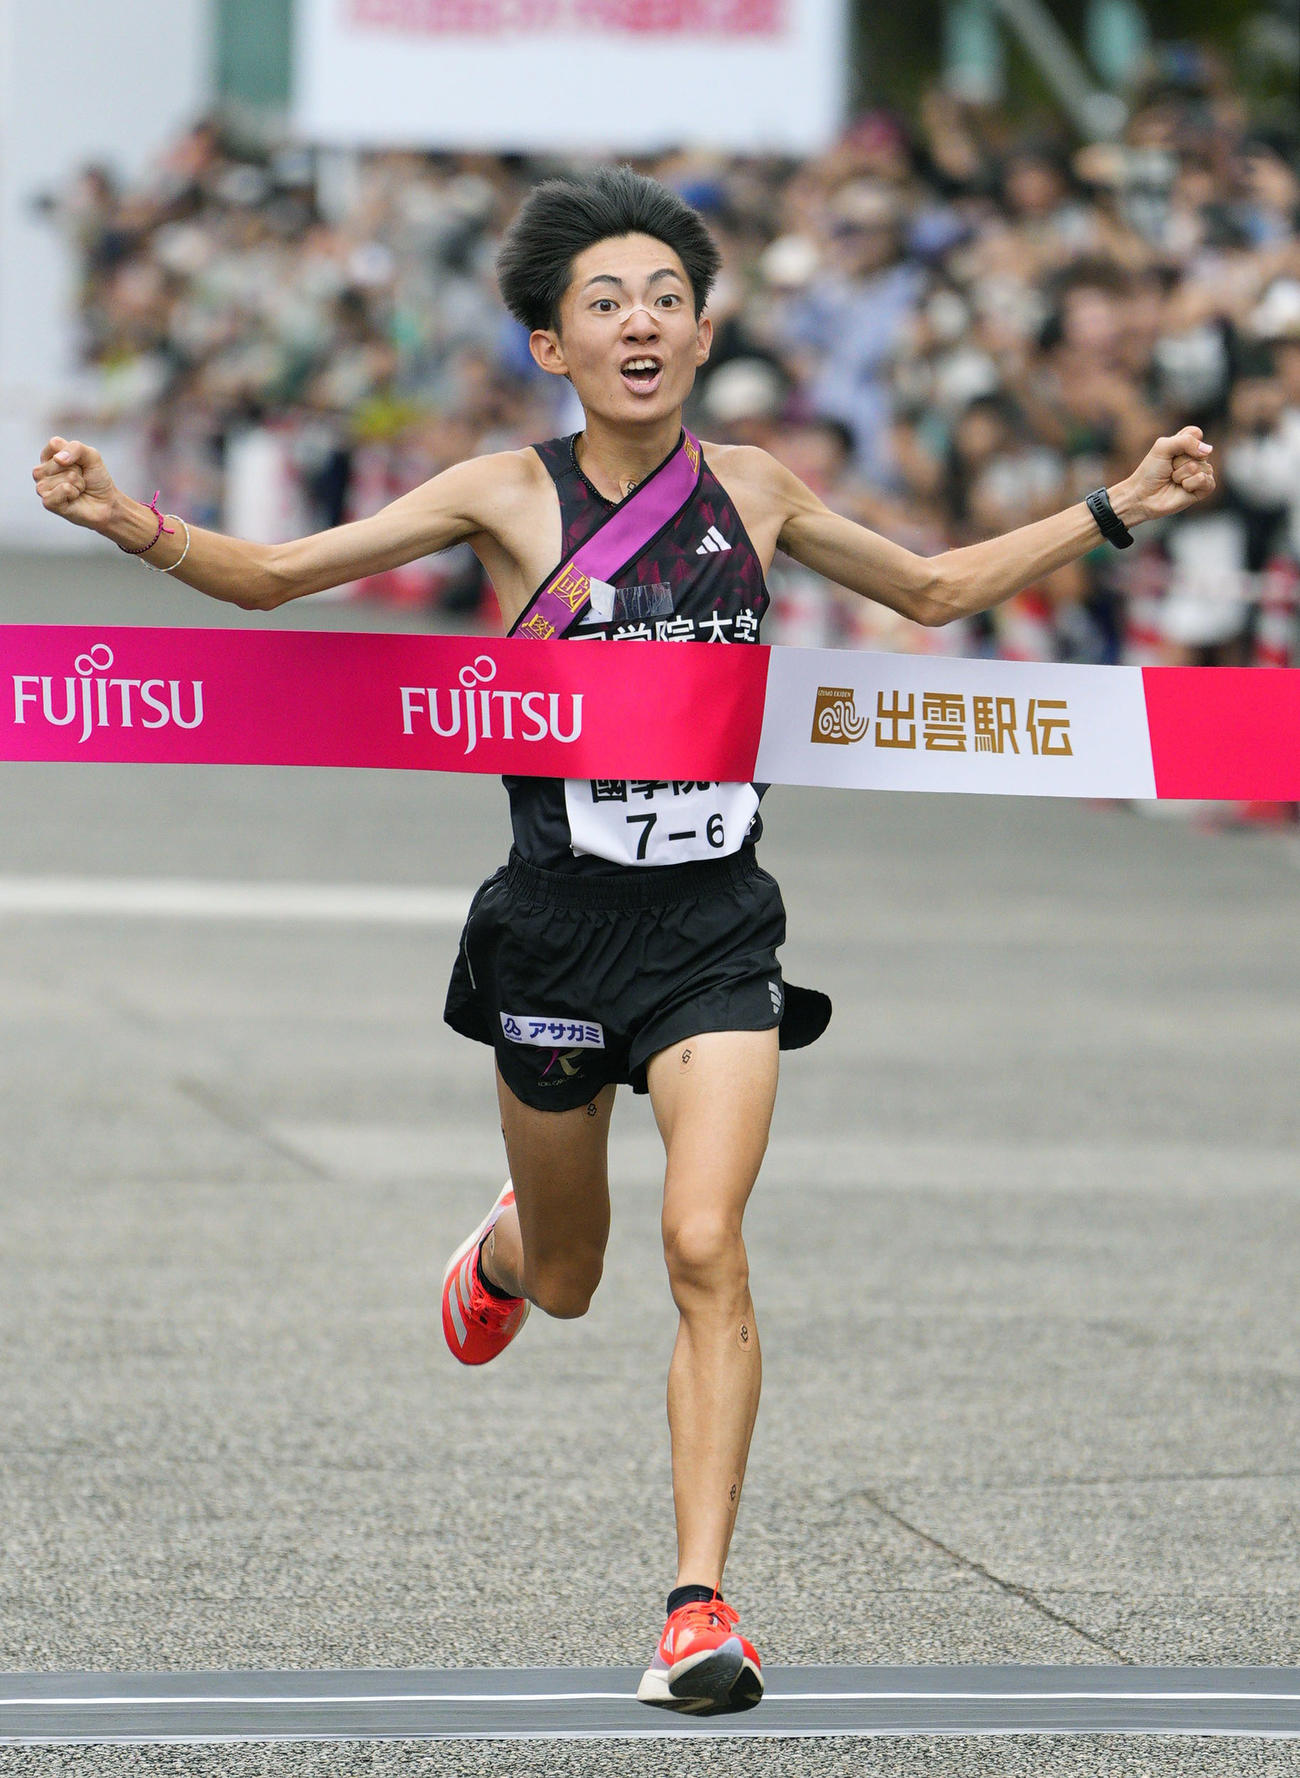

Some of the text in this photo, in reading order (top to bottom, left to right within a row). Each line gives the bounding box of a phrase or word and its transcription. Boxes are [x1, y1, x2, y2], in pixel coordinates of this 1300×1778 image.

[568, 608, 758, 644] 学院大学
[12, 675, 204, 744] FUJITSU
[400, 686, 584, 755] FUJITSU
[875, 690, 1073, 756] 出雲駅伝
[528, 1021, 601, 1044] アサガミ
